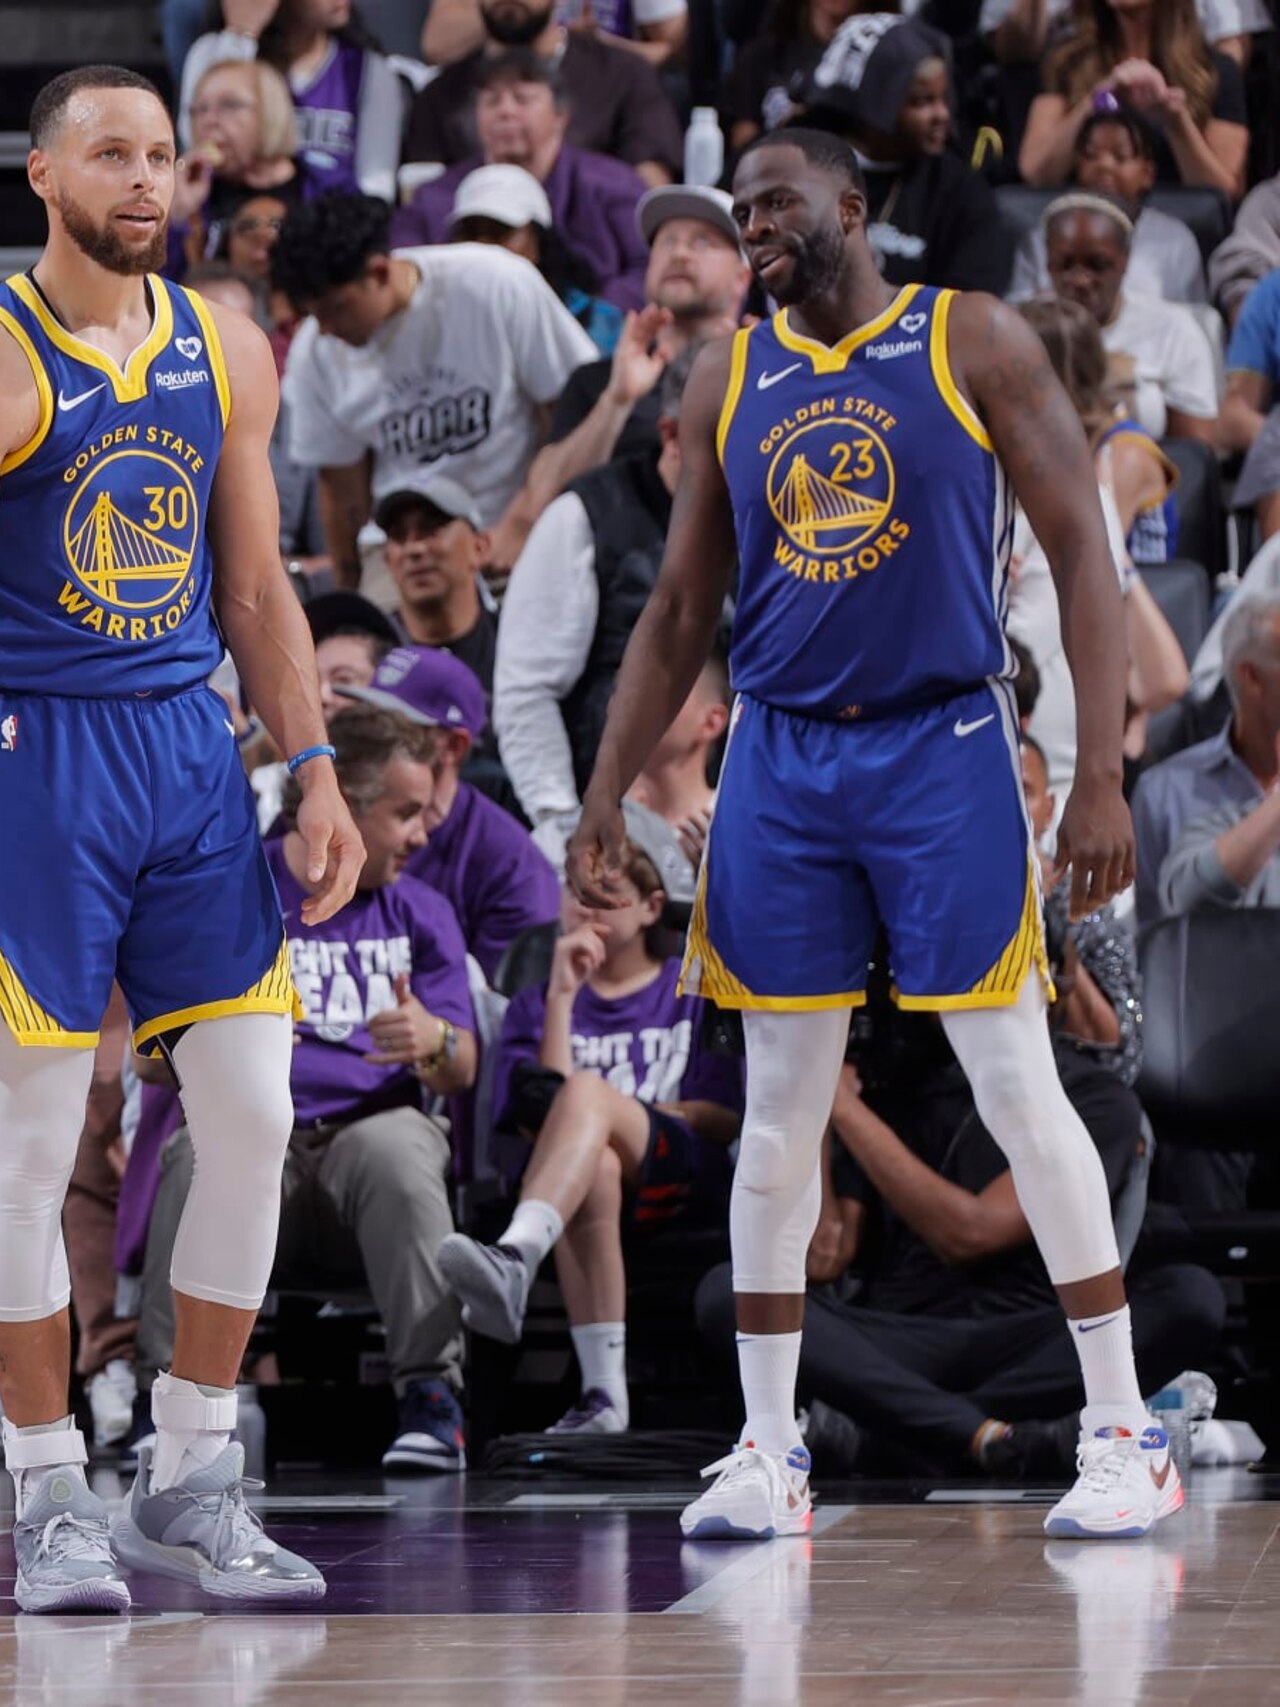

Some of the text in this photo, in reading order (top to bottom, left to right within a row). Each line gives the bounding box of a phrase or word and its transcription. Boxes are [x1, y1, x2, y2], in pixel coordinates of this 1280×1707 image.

[866, 339, 922, 360] Rakuten
[155, 369, 209, 389] Rakuten
[759, 396, 897, 454] GOLDEN STATE
[63, 424, 205, 483] GOLDEN STATE
[830, 439, 876, 482] 23
[143, 485, 188, 531] 30
[773, 517, 911, 583] WARRIORS
[355, 935, 412, 979] THE
